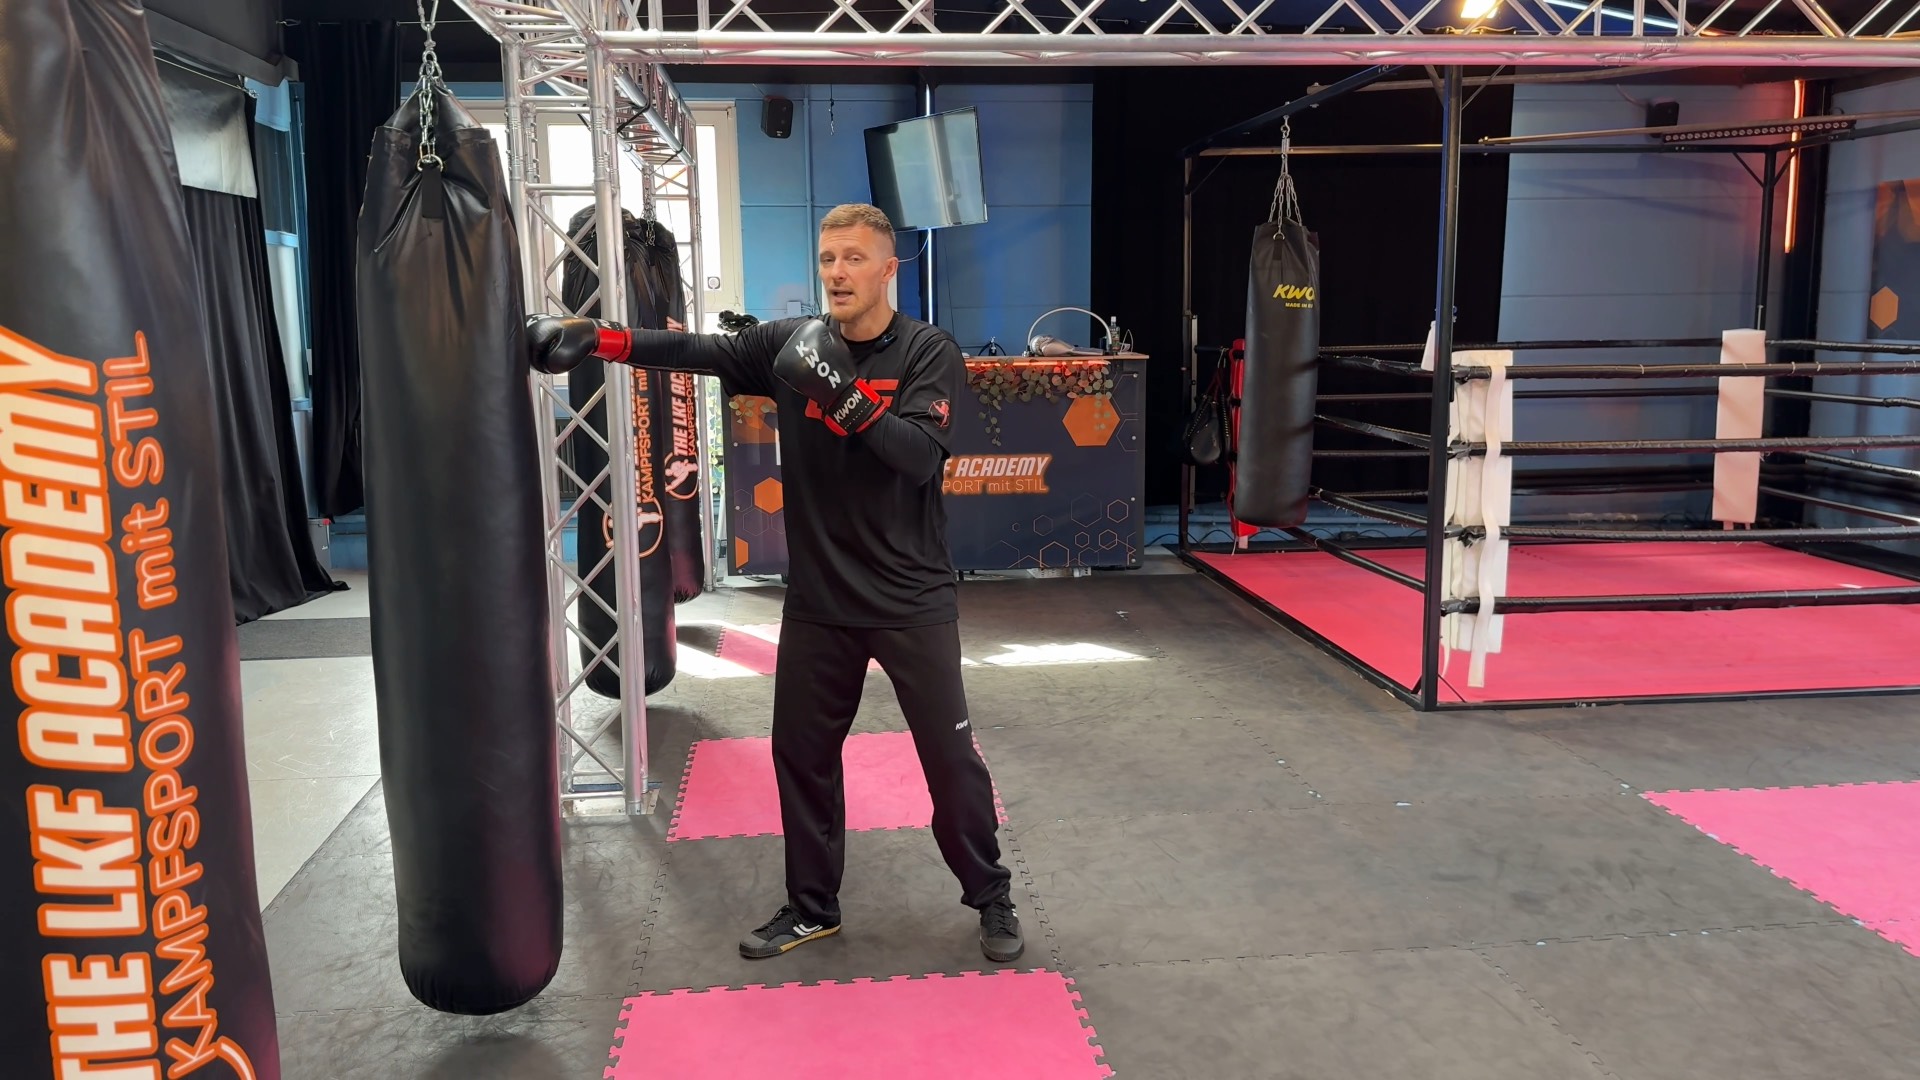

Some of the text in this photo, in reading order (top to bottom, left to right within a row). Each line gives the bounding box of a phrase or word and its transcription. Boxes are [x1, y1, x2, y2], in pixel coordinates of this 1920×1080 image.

[1272, 284, 1315, 301] KWO
[795, 340, 842, 389] KWON
[671, 397, 688, 427] LKF
[685, 373, 697, 455] KAMPFSPORT
[833, 389, 863, 423] KWON
[636, 395, 654, 503] KAMPFSPORT
[673, 427, 688, 456] THE
[954, 457, 1050, 477] ACADEMY
[988, 480, 1010, 491] mit
[1015, 478, 1047, 491] STIL
[0, 326, 160, 1080] THE LKF ACADEMY
[105, 331, 216, 1078] KAMPFSPORT mit STIL
